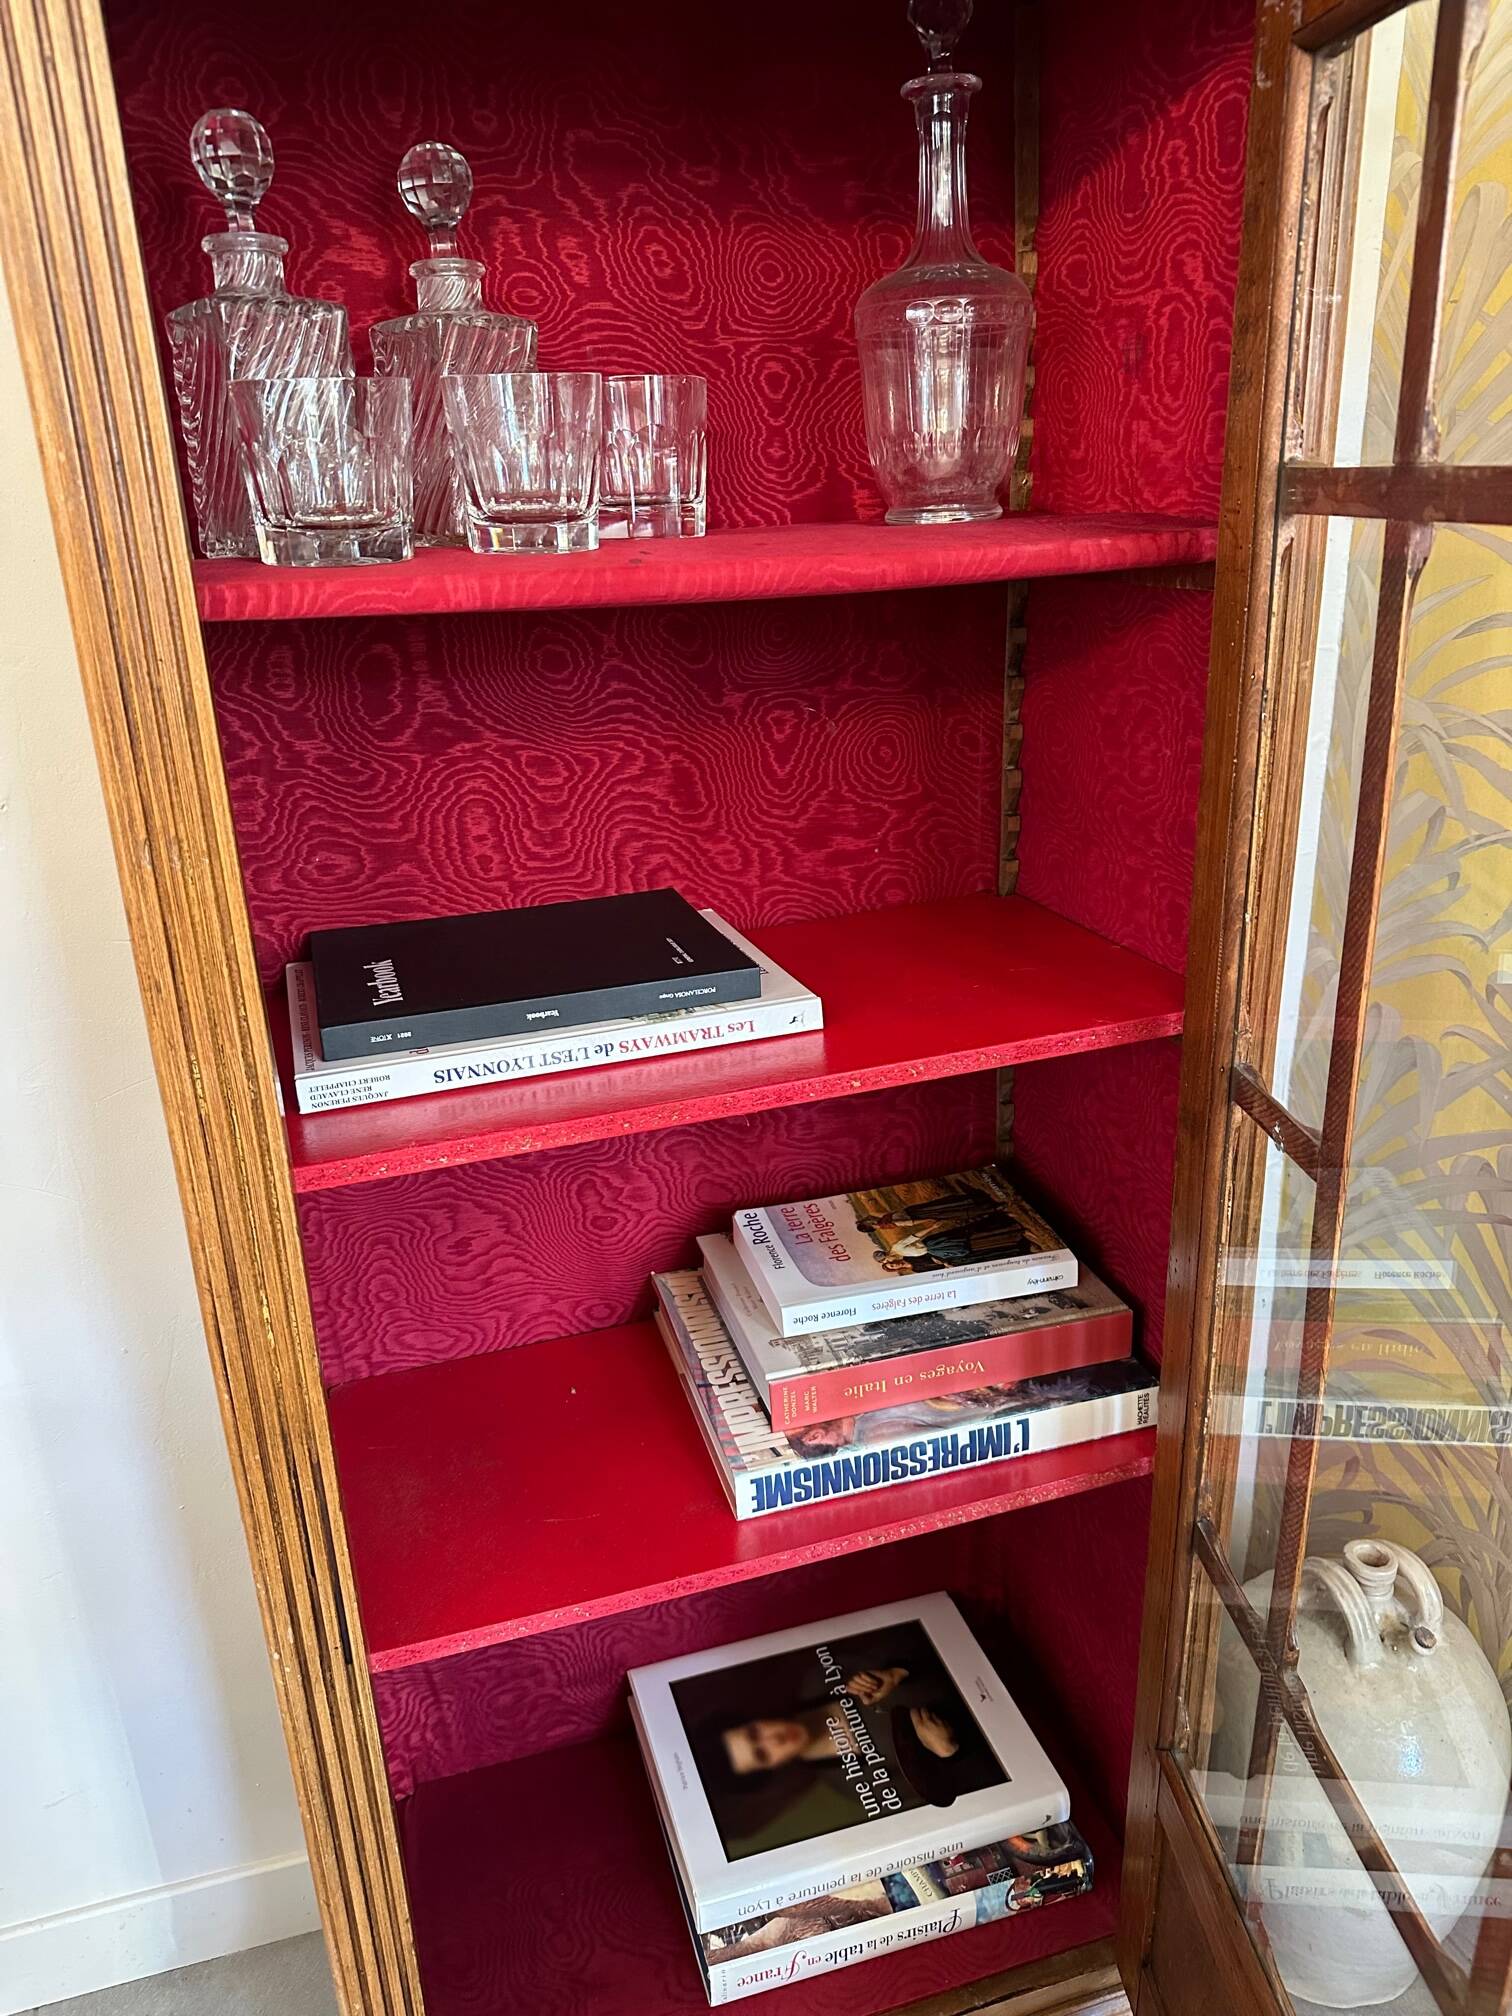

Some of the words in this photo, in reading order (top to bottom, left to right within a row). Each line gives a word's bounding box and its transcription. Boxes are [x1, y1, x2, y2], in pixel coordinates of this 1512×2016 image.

[362, 959, 404, 1006] Yearbook
[526, 1008, 560, 1022] Yearbook
[726, 1019, 756, 1035] Les
[617, 1023, 725, 1054] TRAMWAYS
[537, 1042, 590, 1069] L'EST
[593, 1043, 615, 1058] de
[433, 1051, 535, 1086] LYONNAIS
[308, 1080, 357, 1093] CHAPPELET
[358, 1074, 391, 1085] ROBERT
[310, 1089, 349, 1101] CLAVAUD
[311, 1096, 350, 1109] PERENON
[352, 1091, 389, 1103] JACQUES
[743, 1212, 771, 1245] Roche
[780, 1207, 801, 1232] terre
[803, 1203, 838, 1244] Falgères
[794, 1232, 814, 1245] La
[764, 1244, 785, 1270] Florence
[828, 1243, 851, 1262] des
[871, 1296, 906, 1312] Falgères
[908, 1296, 922, 1306] des
[924, 1292, 945, 1304] terre
[947, 1290, 957, 1300] La
[792, 1314, 820, 1326] Roche
[820, 1308, 857, 1320] Florence
[894, 1374, 913, 1386] en
[919, 1360, 986, 1382] Voyages
[844, 1379, 887, 1400] Italie
[782, 1386, 790, 1425] CATHERINE
[810, 1385, 818, 1414] WALTER
[748, 1417, 1030, 1515] L'IMPRESSIONNISME
[815, 1646, 843, 1683] Lyon
[830, 1684, 848, 1695] à
[838, 1698, 886, 1766] peinture
[824, 1716, 864, 1781] histoire
[872, 1768, 890, 1786] la
[854, 1781, 881, 1818] une
[880, 1787, 902, 1811] de
[938, 1841, 964, 1857] une
[886, 1850, 936, 1872] histoire
[850, 1872, 862, 1883] la
[866, 1866, 882, 1878] de
[788, 1872, 846, 1903] peinture
[907, 1868, 933, 1898] CHAMP
[738, 1898, 770, 1918] Lyon
[775, 1896, 784, 1906] à
[897, 1908, 962, 1942] Plaisirs
[866, 1939, 878, 1950] la
[879, 1935, 894, 1946] de
[807, 1955, 822, 1965] en
[824, 1943, 864, 1965] table
[736, 1950, 807, 1988] France
